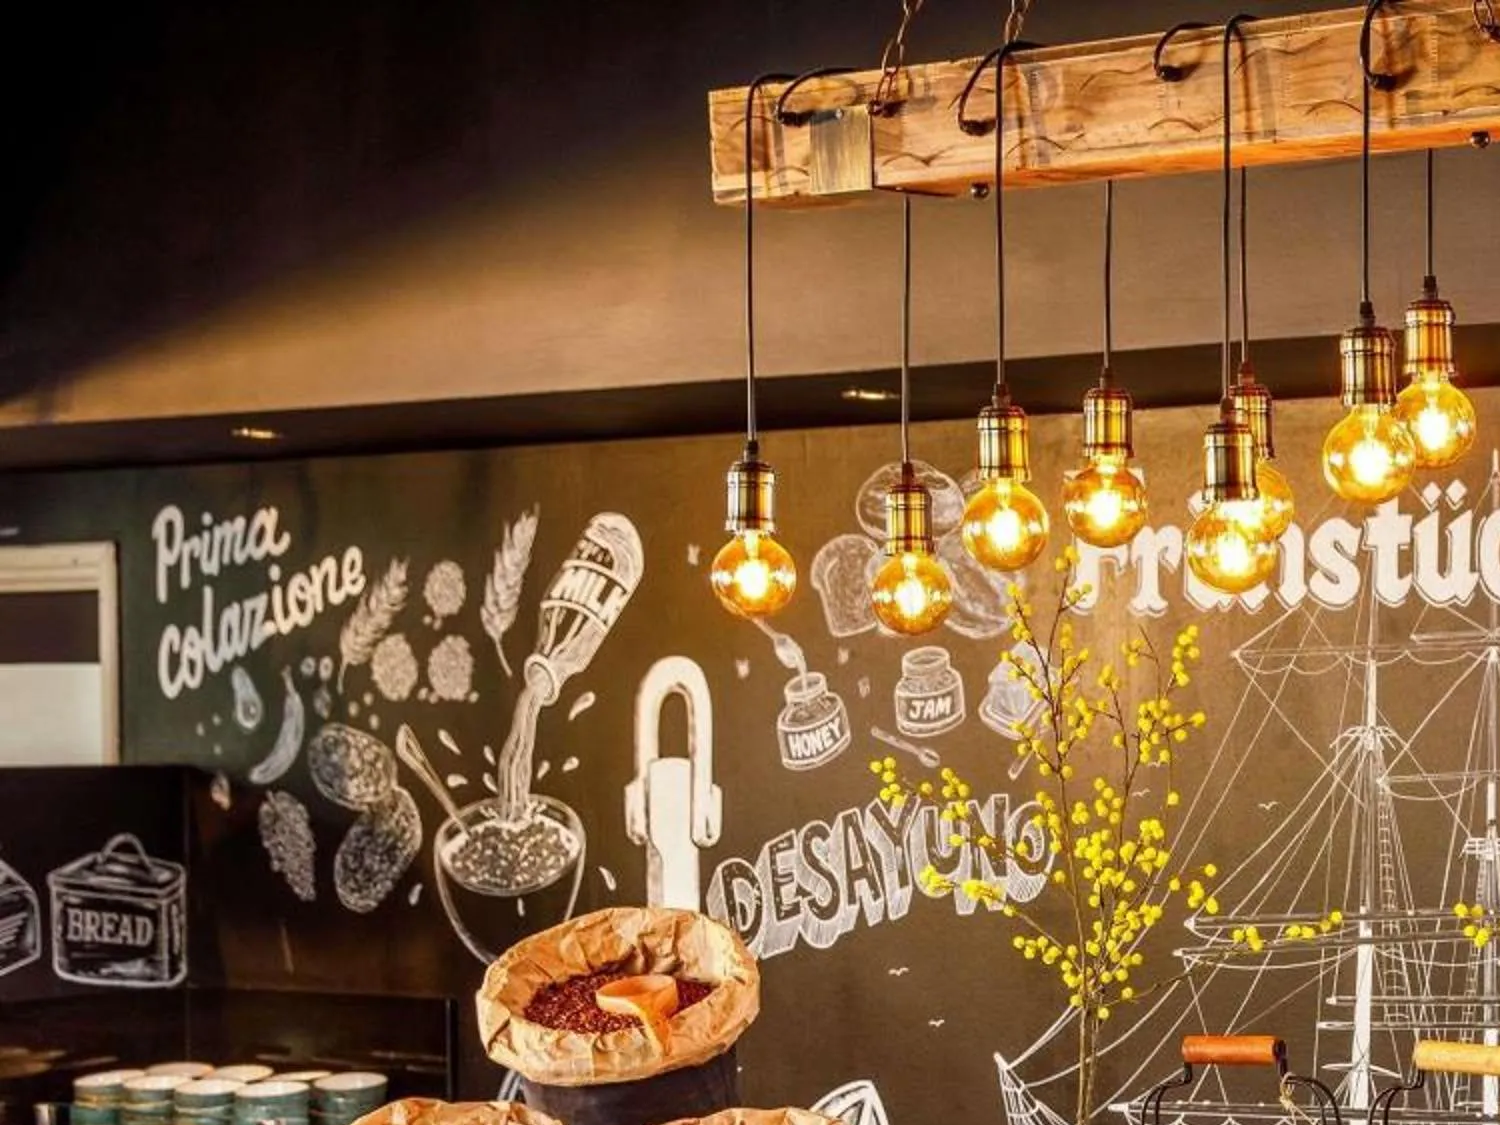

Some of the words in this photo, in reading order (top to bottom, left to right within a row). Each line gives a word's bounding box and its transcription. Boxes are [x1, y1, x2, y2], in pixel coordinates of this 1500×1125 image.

[152, 504, 291, 603] Prima
[158, 545, 366, 699] colazione
[550, 566, 627, 627] MILK
[788, 718, 841, 758] HONEY
[909, 695, 953, 720] JAM
[712, 793, 1057, 955] DESAYUNO
[66, 907, 154, 947] BREAD
